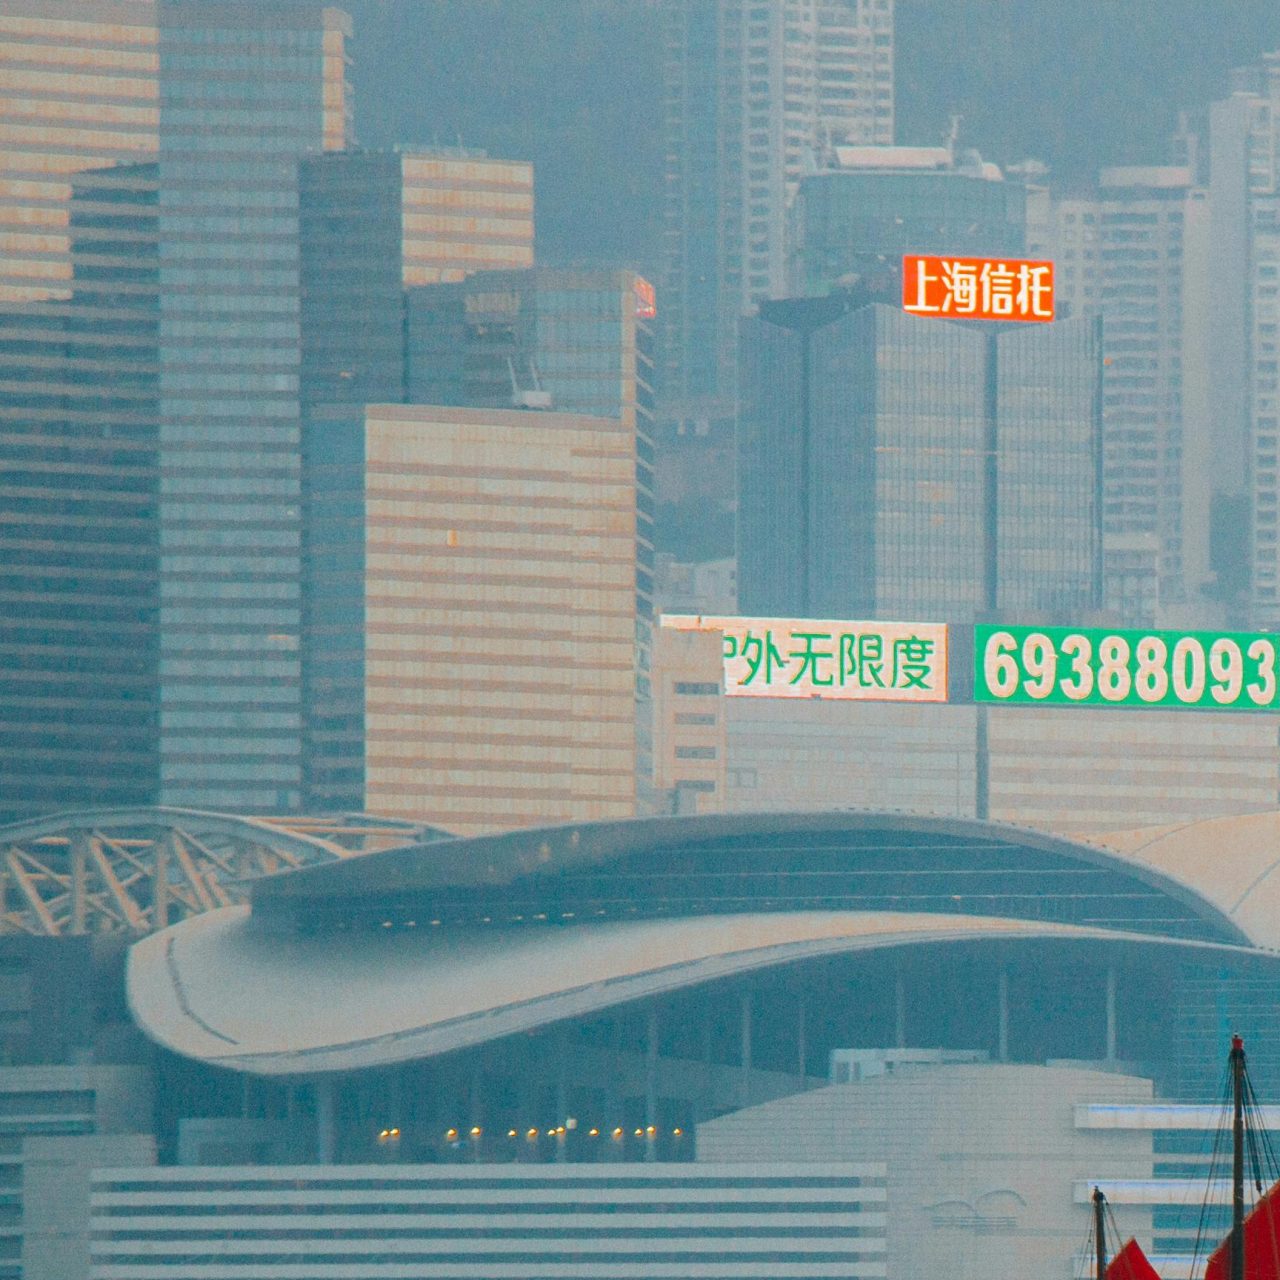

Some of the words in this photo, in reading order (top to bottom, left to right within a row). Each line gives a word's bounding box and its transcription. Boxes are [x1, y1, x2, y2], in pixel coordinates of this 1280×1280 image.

[903, 260, 1052, 316] 上海信托
[984, 631, 1276, 705] 69388093
